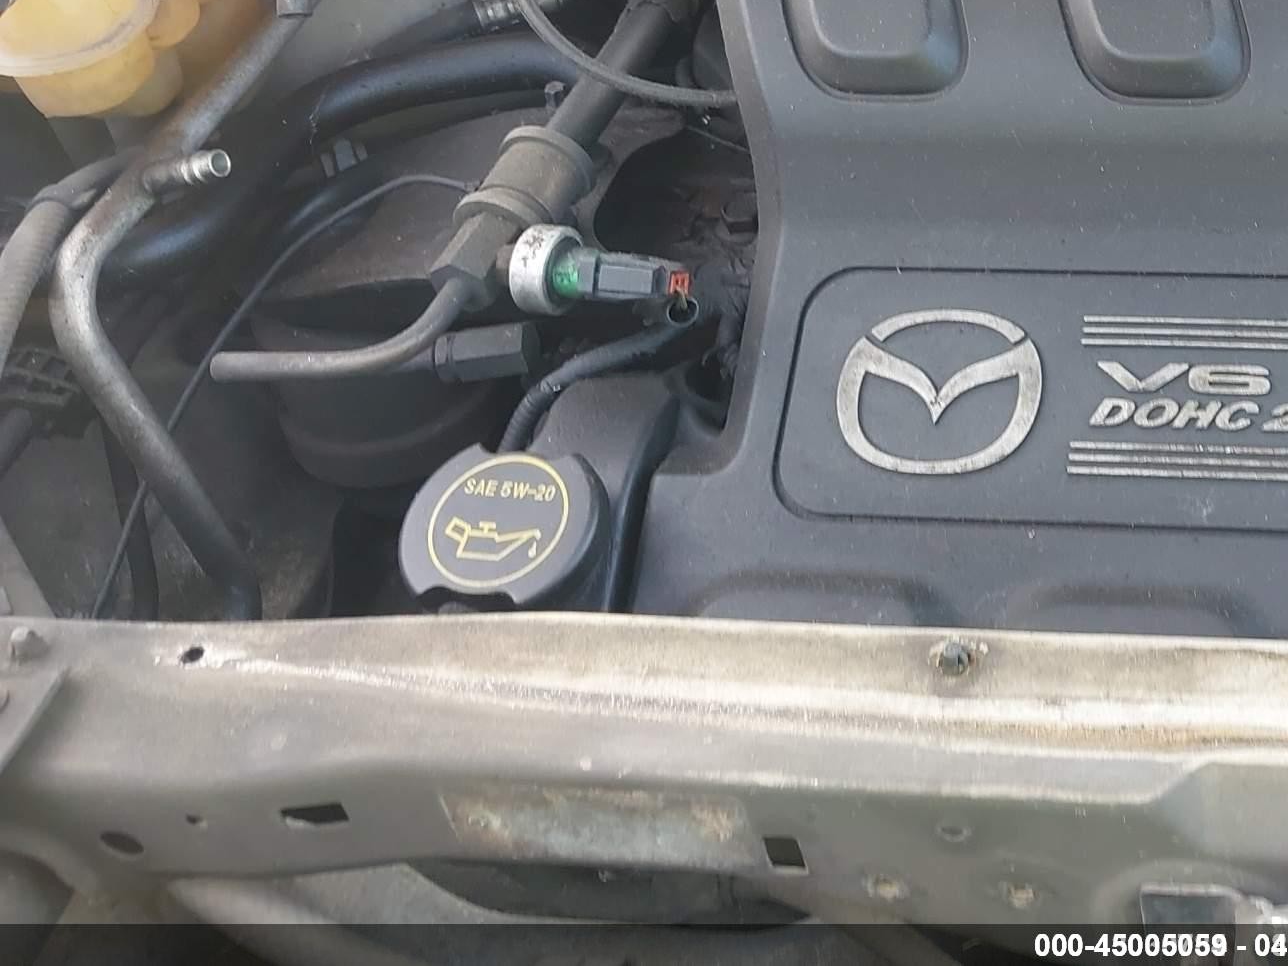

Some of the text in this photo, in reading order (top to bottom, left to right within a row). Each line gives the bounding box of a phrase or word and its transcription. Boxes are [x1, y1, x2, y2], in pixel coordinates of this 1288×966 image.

[1097, 360, 1271, 395] V6
[1089, 397, 1260, 429] DOHC
[464, 477, 556, 502] SAE 5W-20
